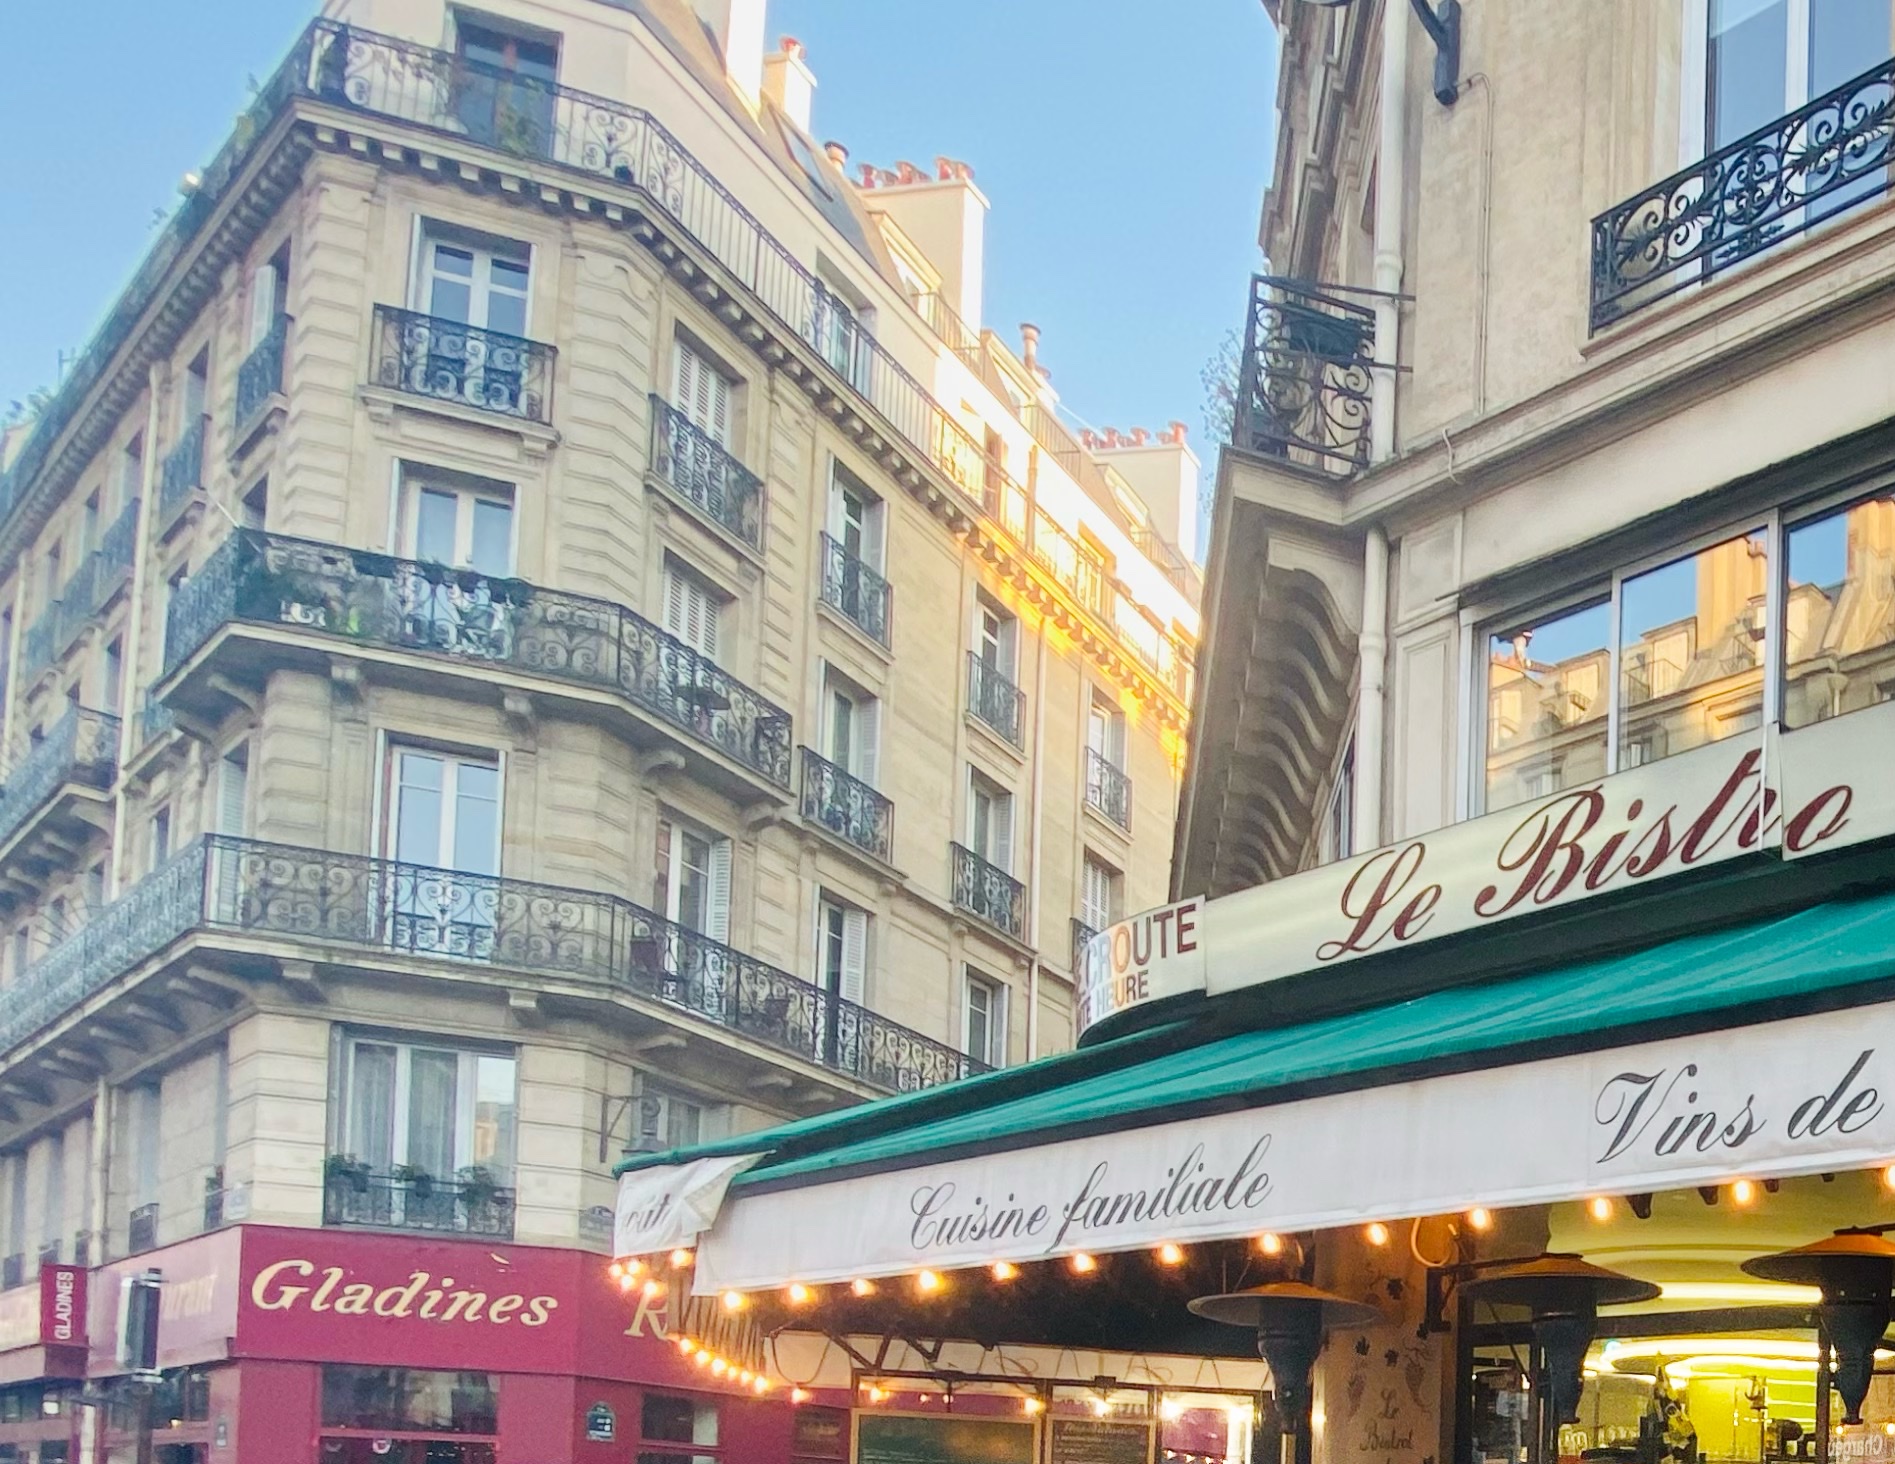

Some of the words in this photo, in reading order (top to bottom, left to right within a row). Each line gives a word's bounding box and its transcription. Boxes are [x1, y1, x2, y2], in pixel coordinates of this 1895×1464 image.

[1315, 842, 1442, 962] Le
[1473, 746, 1854, 918] Bistro
[1596, 1063, 1765, 1164] Vins
[1788, 1049, 1884, 1140] de
[910, 1184, 1052, 1250] Cuisine
[1046, 1132, 1274, 1254] familiale
[54, 1271, 75, 1341] GLADINES
